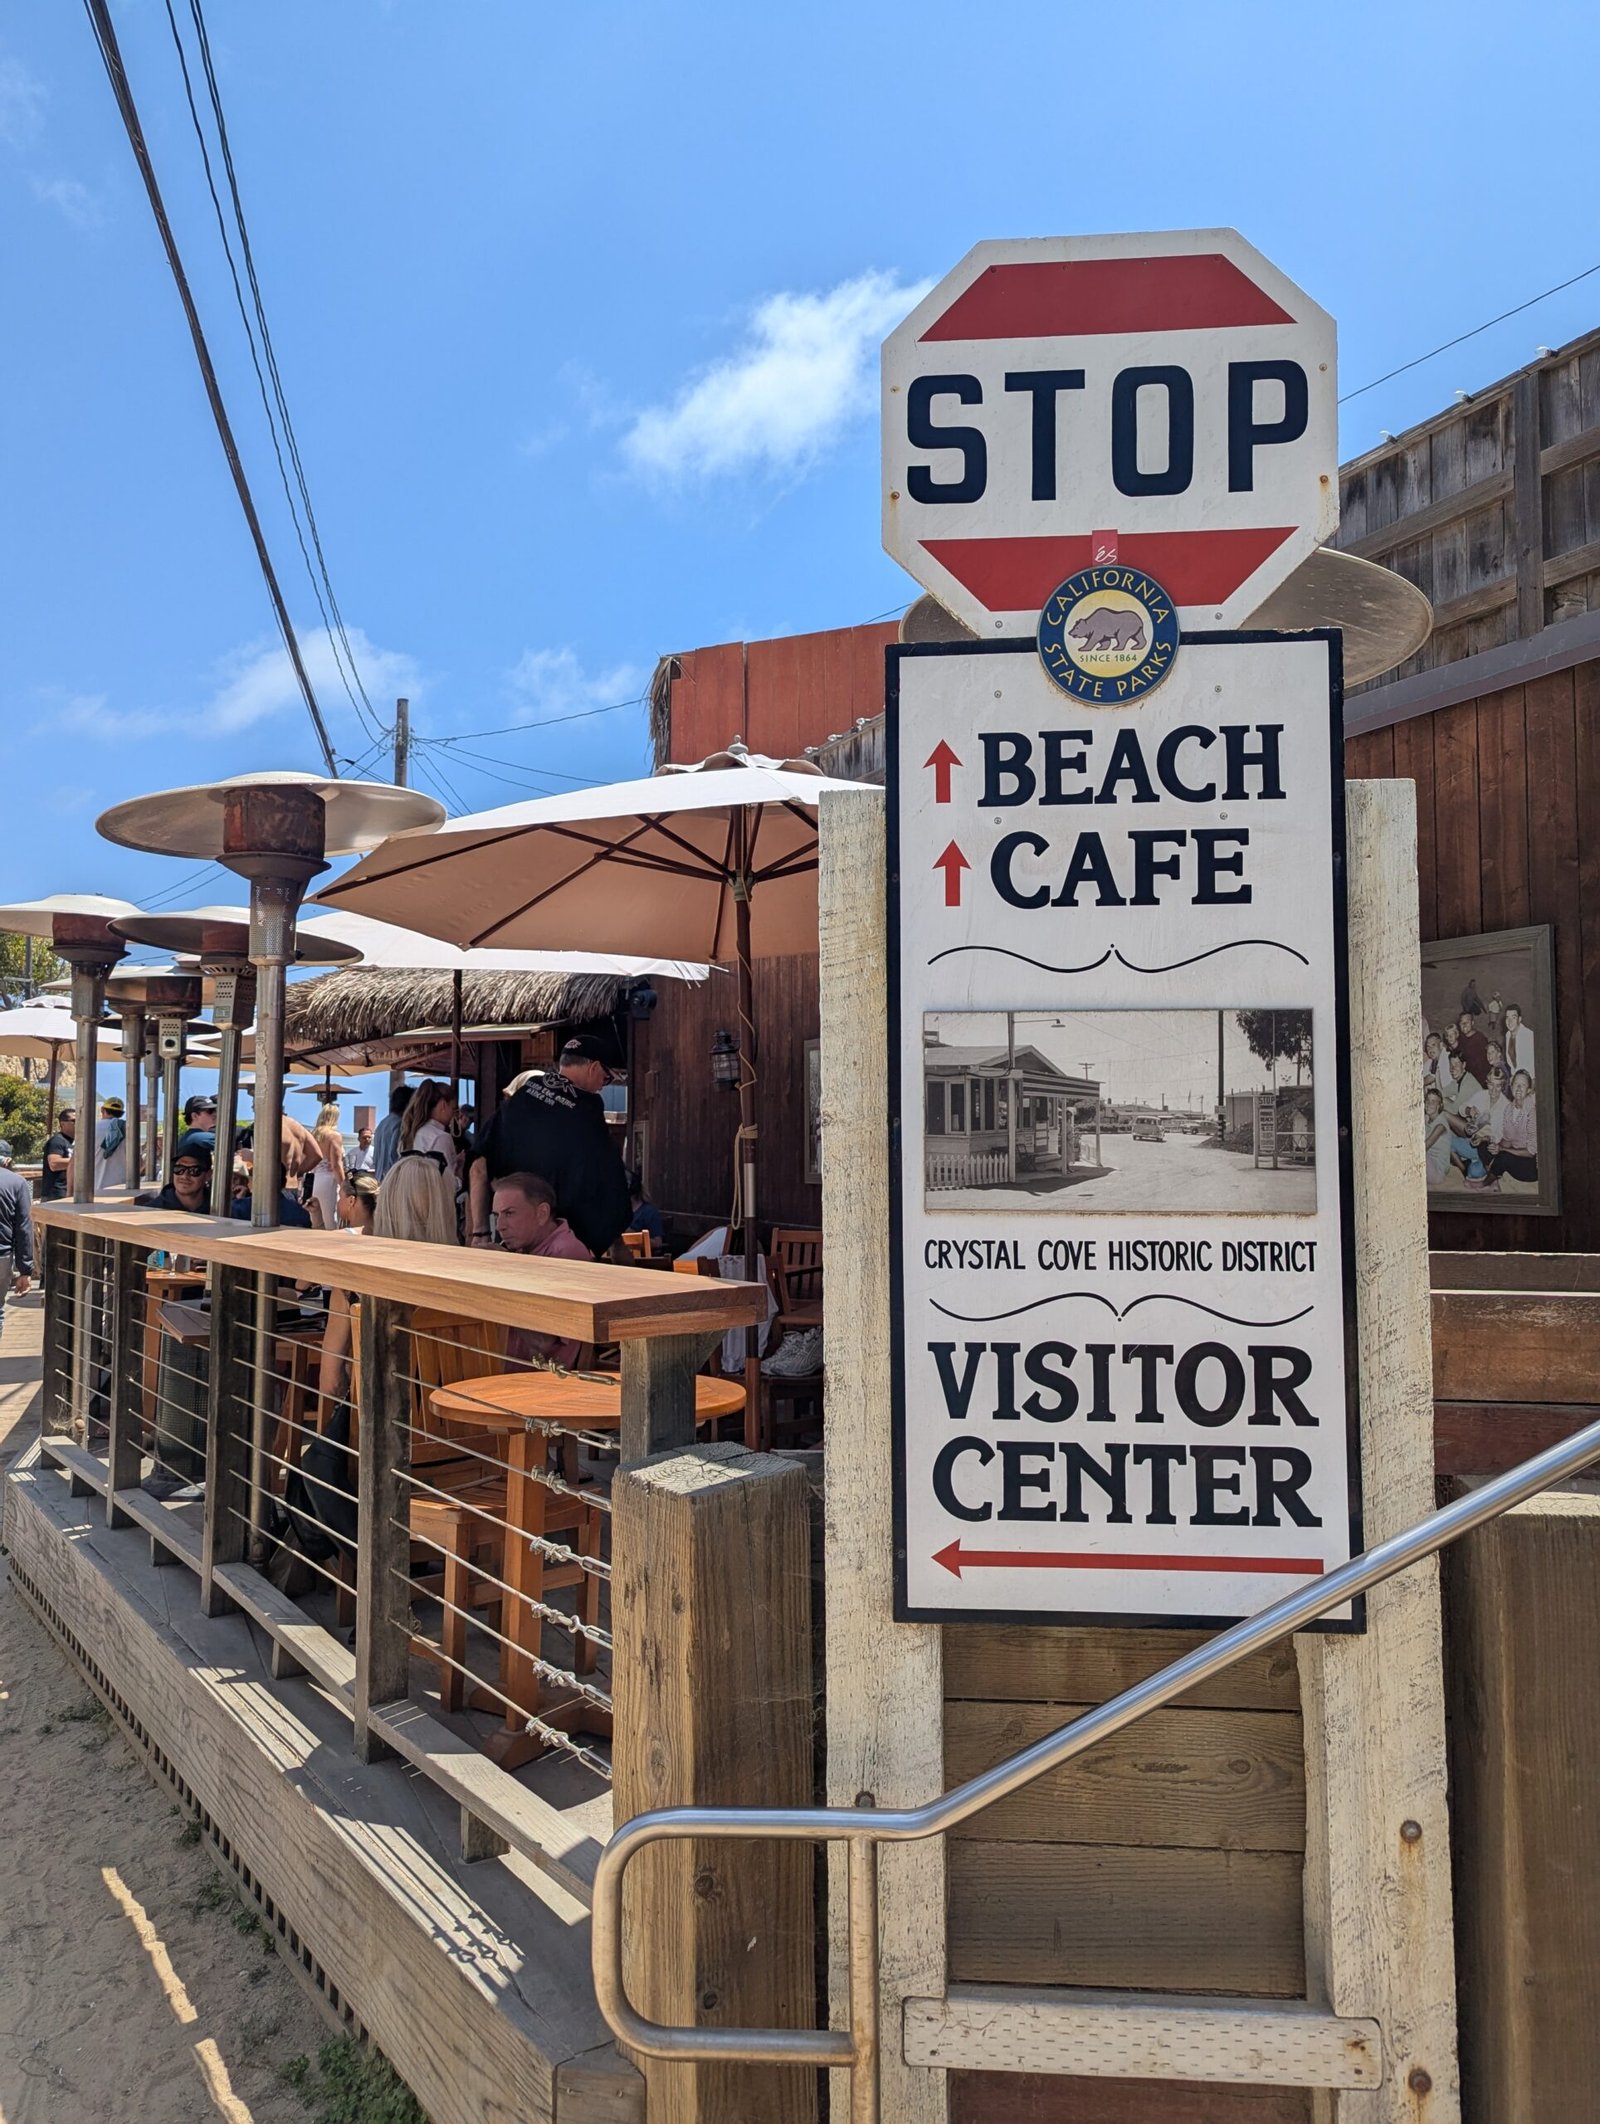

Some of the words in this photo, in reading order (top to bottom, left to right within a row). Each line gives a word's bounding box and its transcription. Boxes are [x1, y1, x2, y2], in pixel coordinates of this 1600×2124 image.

[907, 359, 1309, 504] STOP
[1046, 569, 1170, 626] CALIFORNIA
[1044, 642, 1104, 698] STATE
[1116, 641, 1172, 697] PARKS
[1080, 654, 1111, 663] SINCE
[1115, 654, 1137, 663] 1864
[977, 724, 1287, 808] BEACH
[990, 828, 1253, 910] CAFE
[1258, 1096, 1275, 1105] STOP
[924, 1239, 1026, 1271] CRYSTAL
[1037, 1239, 1097, 1271] COVE
[1108, 1240, 1213, 1272] HISTORIC
[1222, 1240, 1318, 1273] DISTRICT
[927, 1340, 1320, 1427] VISITOR
[932, 1435, 1323, 1528] CENTER
